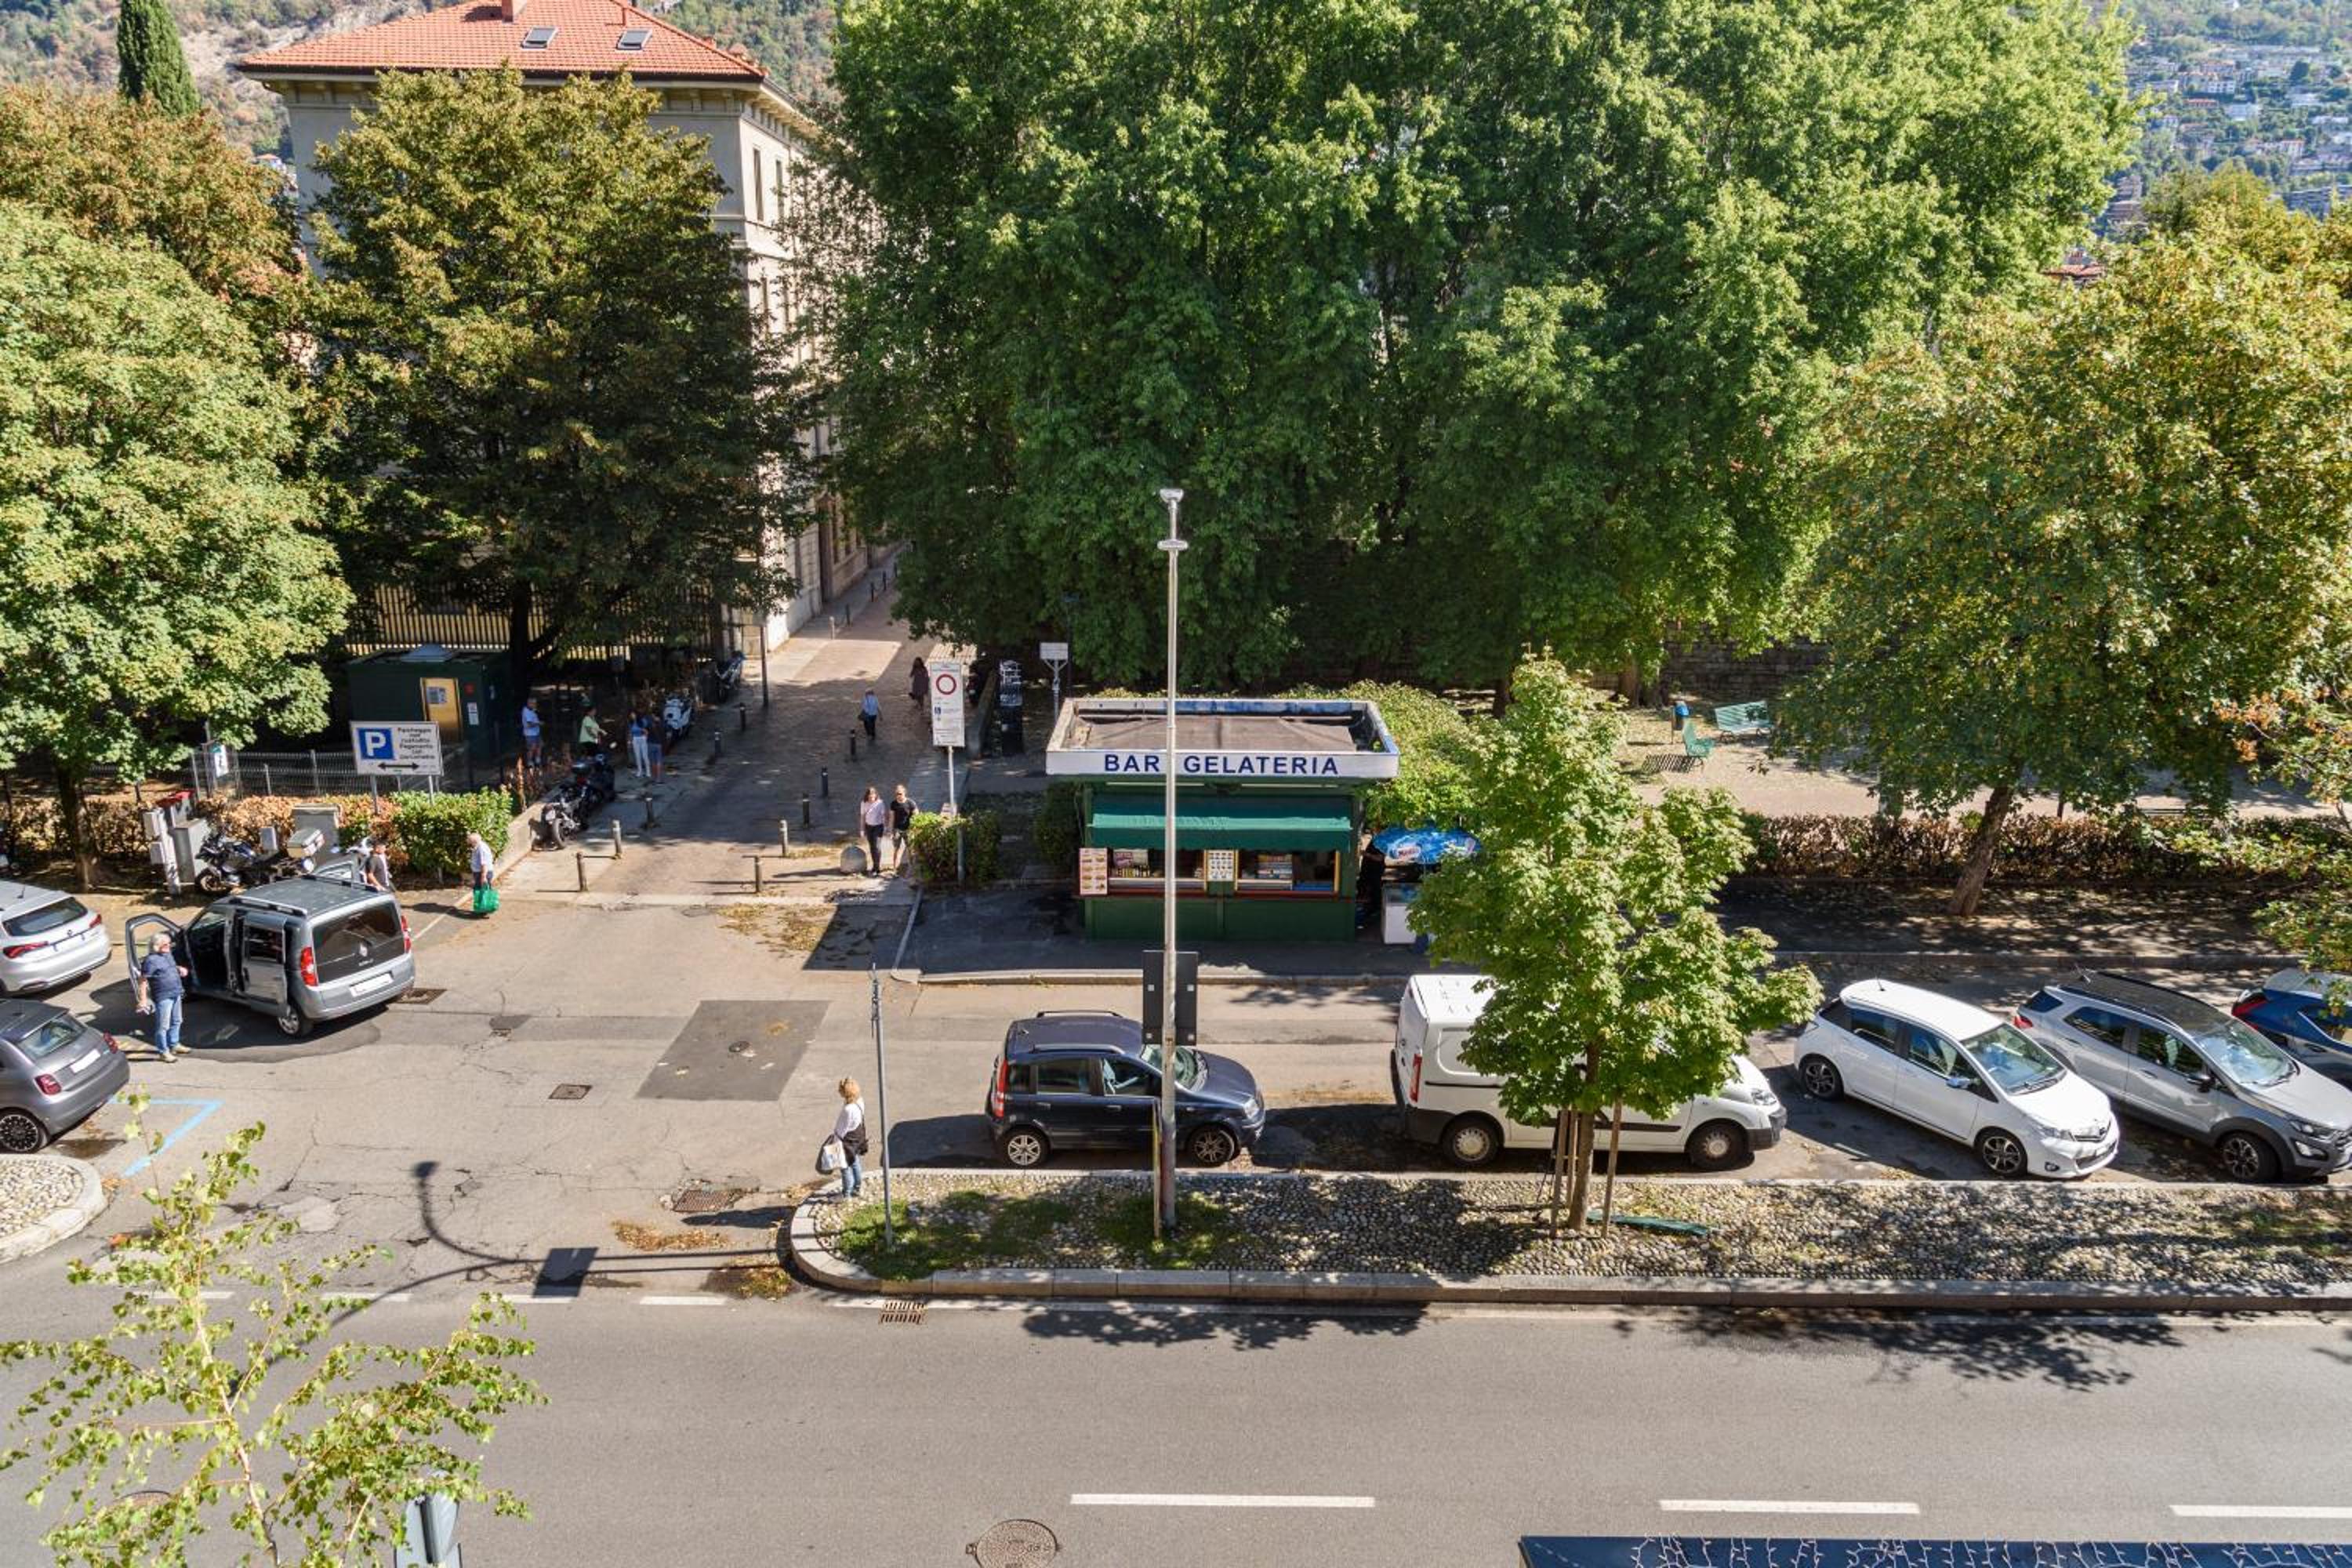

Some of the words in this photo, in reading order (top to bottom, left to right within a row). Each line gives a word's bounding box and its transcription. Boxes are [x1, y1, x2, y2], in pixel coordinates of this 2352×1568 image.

[365, 731, 387, 757] P
[1105, 754, 1160, 772] BAR
[1184, 756, 1339, 775] GELATERIA
